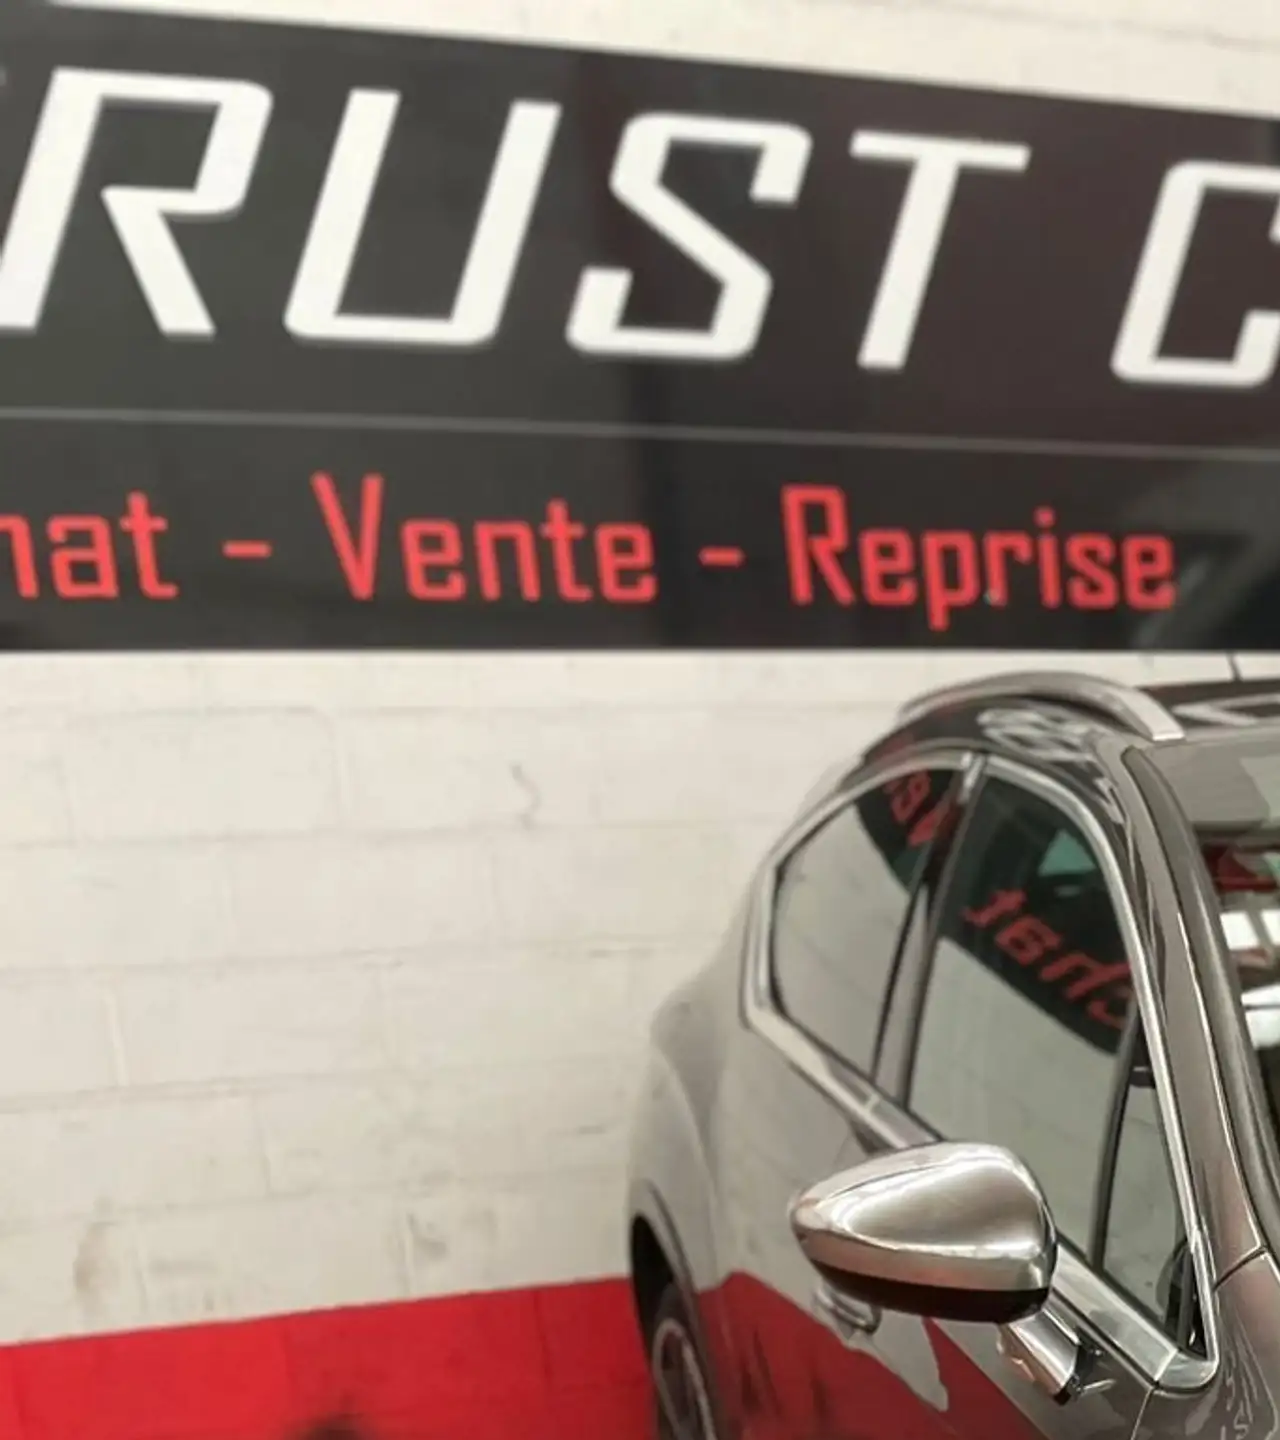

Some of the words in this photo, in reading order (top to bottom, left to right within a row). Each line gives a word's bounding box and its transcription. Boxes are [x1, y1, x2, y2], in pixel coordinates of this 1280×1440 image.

[0, 66, 1031, 370] RUST
[311, 472, 658, 603] Vente
[780, 483, 1177, 632] Reprise
